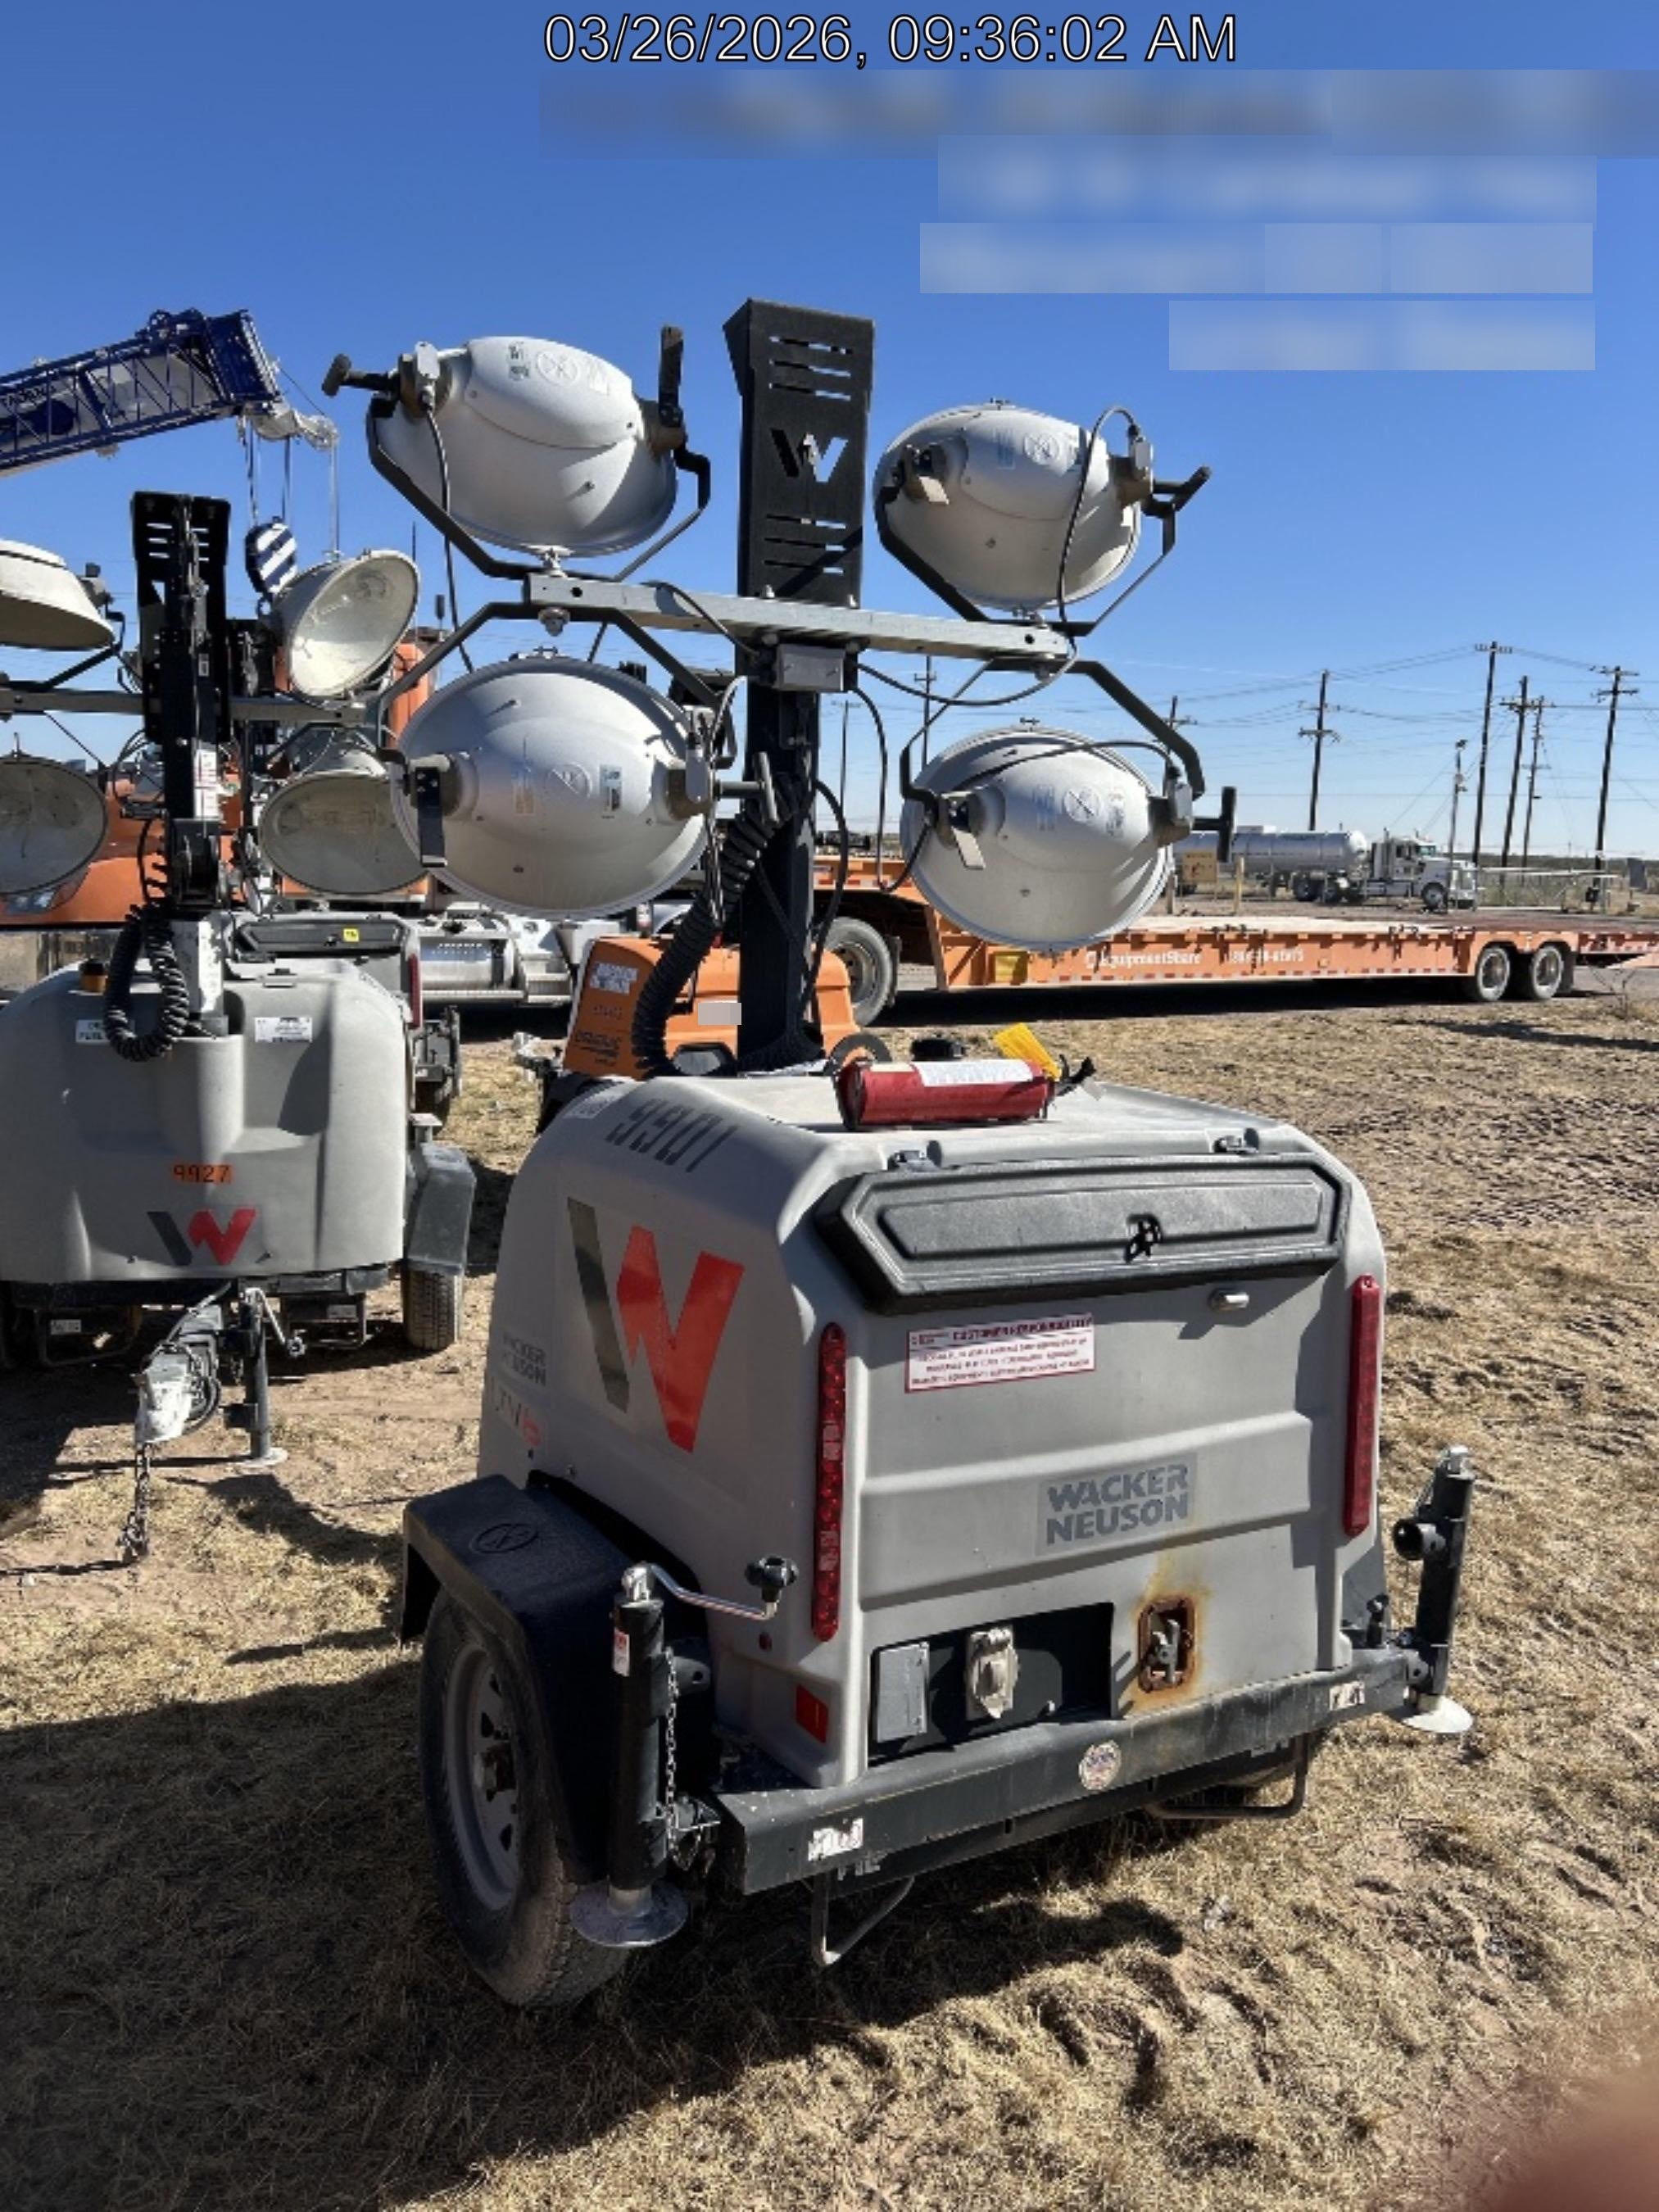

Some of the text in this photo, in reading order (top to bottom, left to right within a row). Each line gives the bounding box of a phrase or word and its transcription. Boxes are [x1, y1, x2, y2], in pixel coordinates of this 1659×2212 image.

[174, 1164, 231, 1184] 9927
[1047, 1463, 1189, 1512] WACKER
[1047, 1491, 1189, 1547] NEUSON
